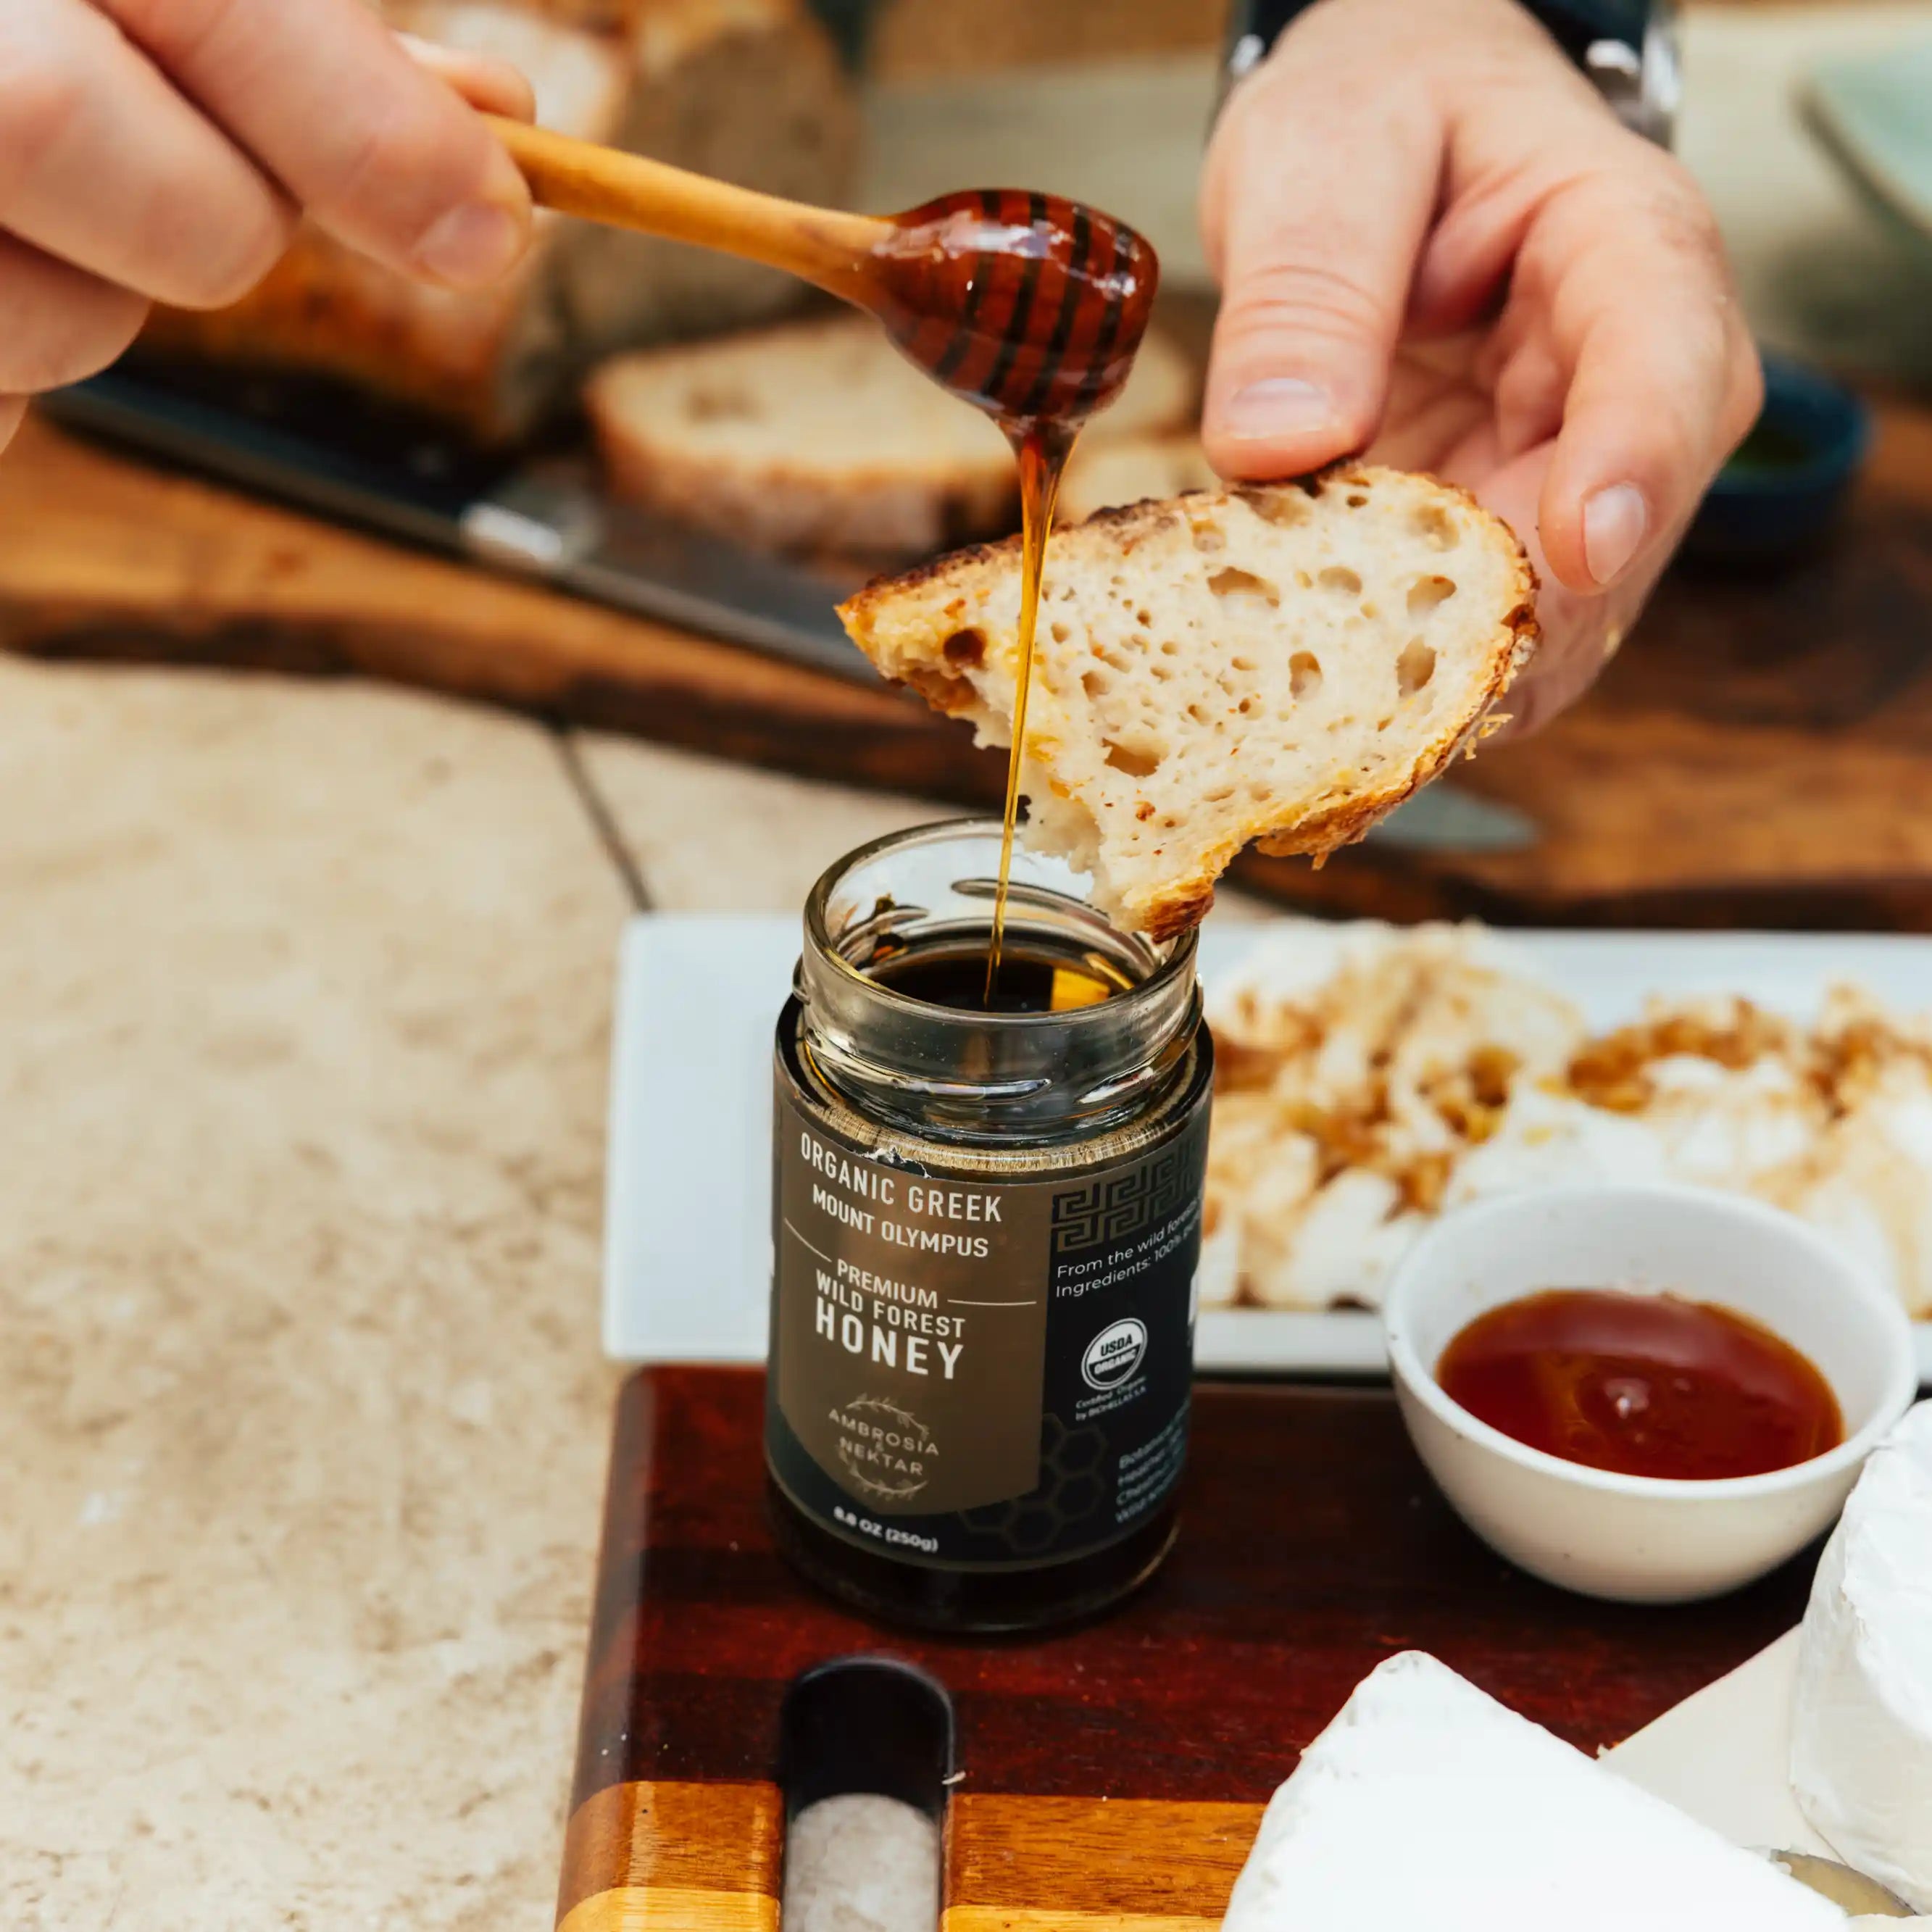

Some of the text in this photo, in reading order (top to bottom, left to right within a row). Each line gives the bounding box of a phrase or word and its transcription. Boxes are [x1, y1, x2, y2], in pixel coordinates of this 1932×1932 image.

[800, 1132, 1002, 1223] ORGANIC GREEK
[813, 1183, 989, 1258] MOUNT OLYMPUS
[1056, 1257, 1152, 1298] Ingredients:
[1057, 1258, 1103, 1278] From
[1108, 1247, 1134, 1265] the
[1137, 1226, 1165, 1253] wild
[816, 1268, 966, 1338] WILD FOREST
[837, 1258, 938, 1309] PREMIUM
[816, 1296, 964, 1380] HONEY
[1100, 1333, 1133, 1357] USDA
[828, 1408, 940, 1457] AMBROSIA
[839, 1436, 924, 1476] NEKTAR
[885, 1527, 939, 1554] (250g)
